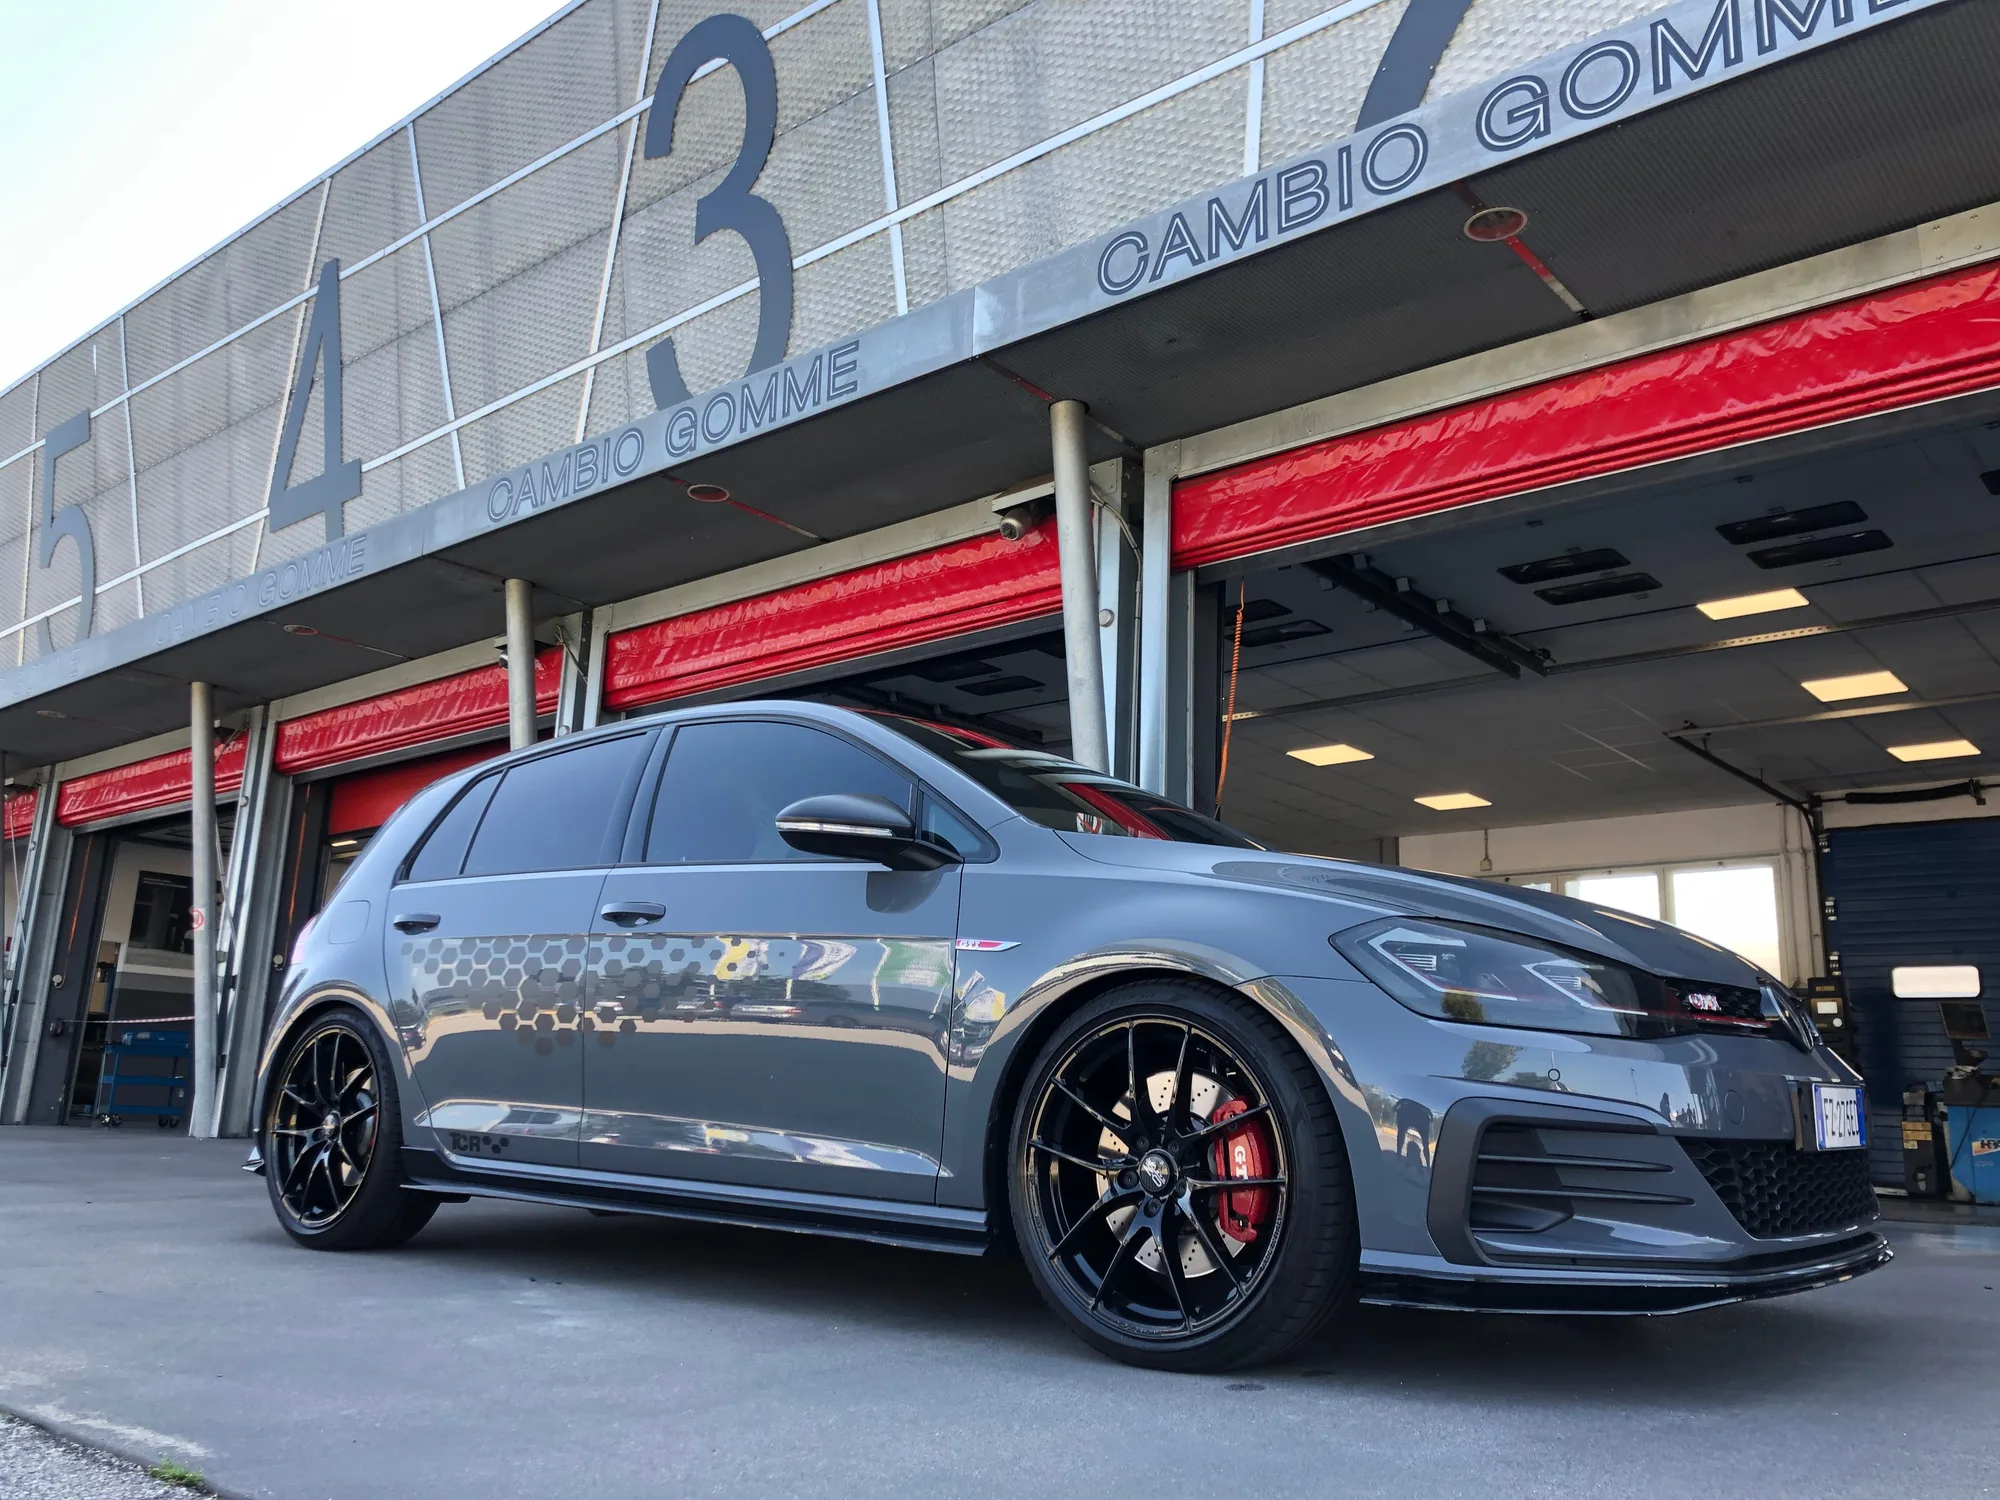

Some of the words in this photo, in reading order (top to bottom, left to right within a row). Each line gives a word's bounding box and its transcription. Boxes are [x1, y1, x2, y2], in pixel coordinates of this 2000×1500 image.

[644, 13, 794, 411] 3
[1097, 123, 1429, 296] CAMBIO
[1475, 0, 1909, 152] GOMM
[269, 257, 362, 544] 4
[487, 427, 645, 523] CAMBIO
[665, 340, 860, 458] GOMME
[37, 408, 96, 652] 5
[258, 533, 367, 608] GOMME
[449, 1132, 480, 1153] TCR
[1234, 1145, 1249, 1181] GT
